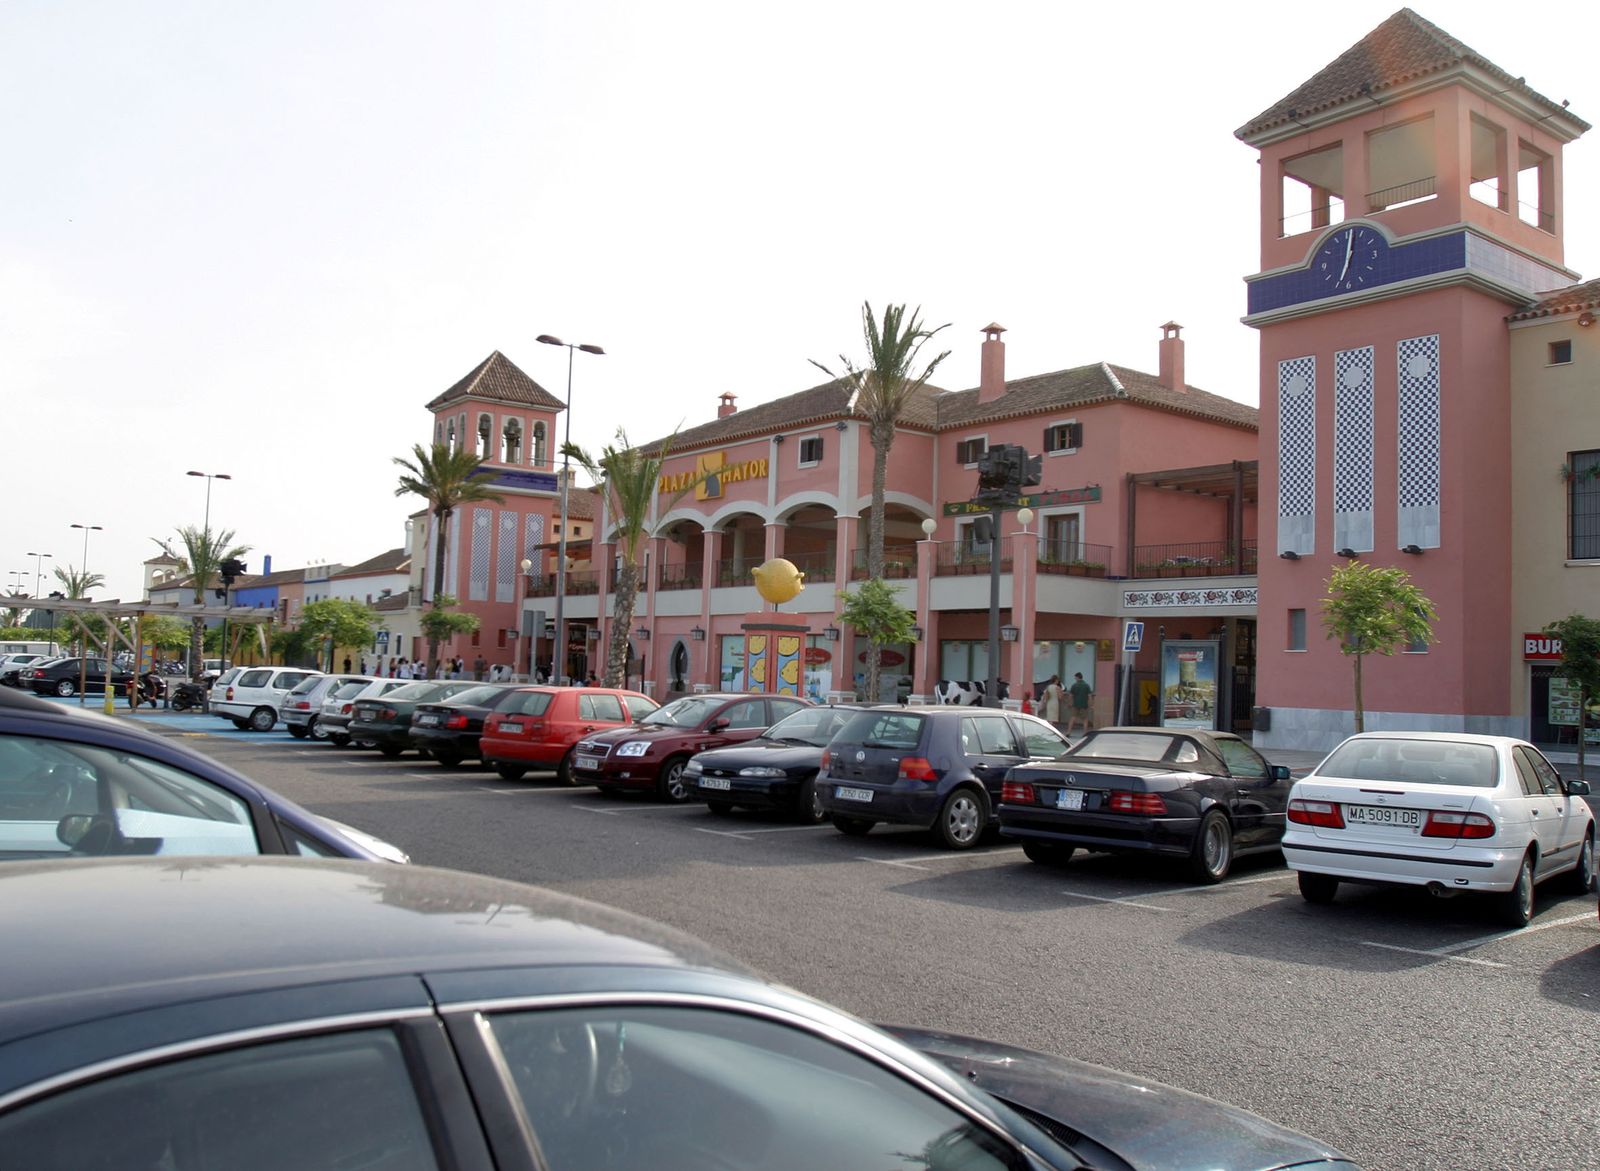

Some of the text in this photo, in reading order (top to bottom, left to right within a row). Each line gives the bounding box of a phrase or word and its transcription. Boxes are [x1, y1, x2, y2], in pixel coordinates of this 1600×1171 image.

[1371, 250, 1378, 260] 3
[1321, 262, 1327, 272] 9
[1345, 280, 1352, 290] 6
[658, 458, 767, 494] PLAZA MAYOR
